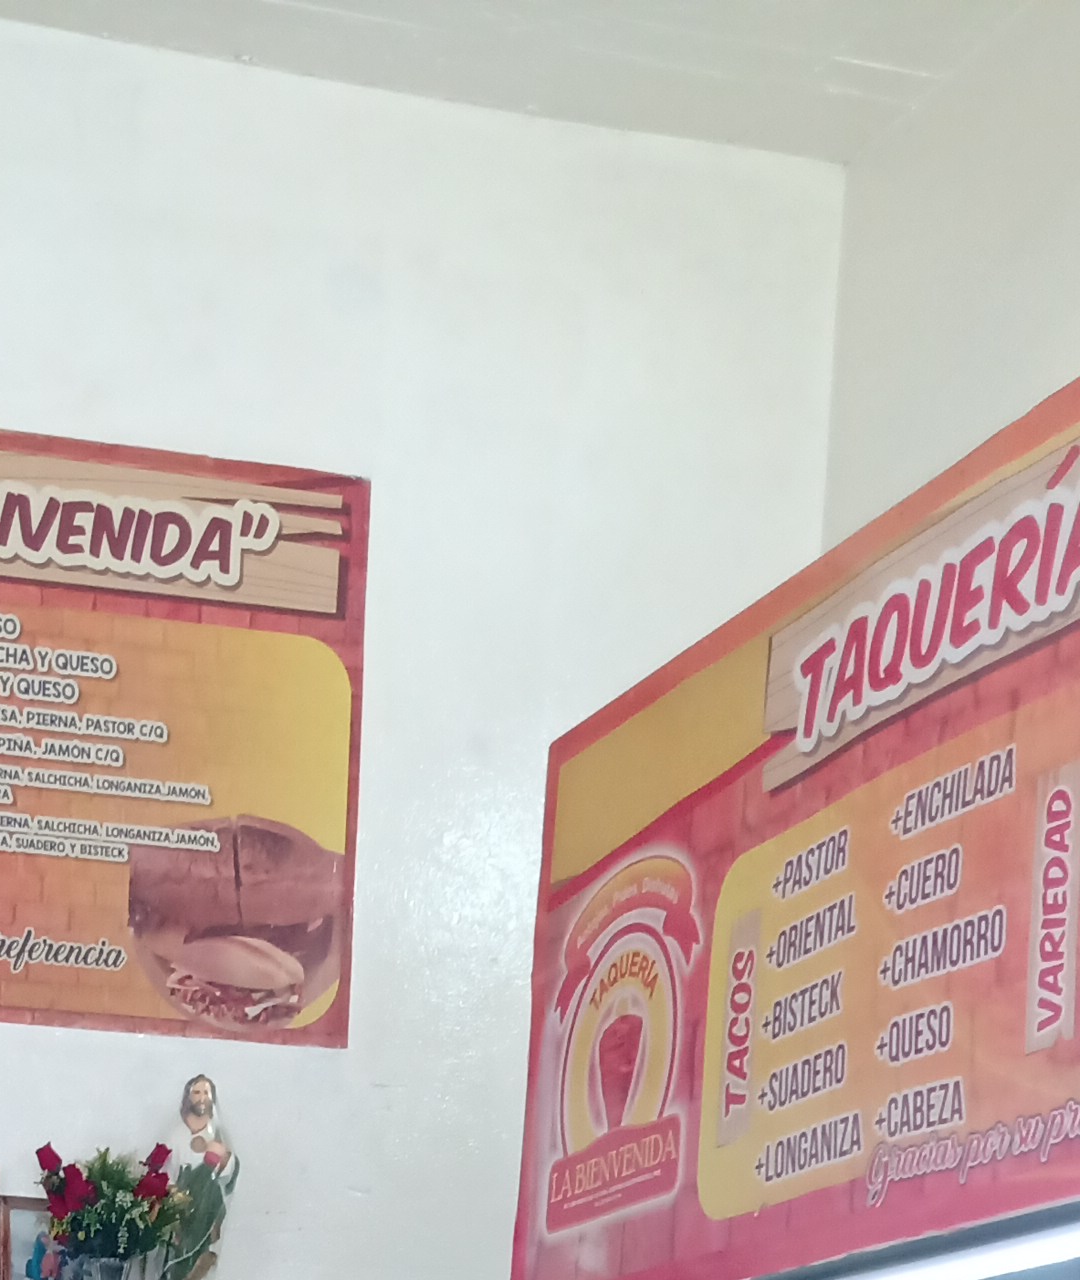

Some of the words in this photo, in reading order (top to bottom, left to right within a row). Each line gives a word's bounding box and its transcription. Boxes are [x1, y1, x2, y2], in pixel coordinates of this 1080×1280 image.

[38, 650, 49, 668] Y
[55, 653, 114, 675] QUESO
[17, 678, 76, 700] QUESO
[86, 718, 136, 736] PASTOR
[140, 724, 164, 739] C/Q
[42, 742, 92, 760] JAMÓN
[95, 748, 120, 763] C/Q
[16, 838, 66, 853] SUADERO
[70, 842, 77, 854] Y
[80, 844, 125, 859] BISTECK
[1037, 788, 1072, 1032] VARIEDAD
[725, 949, 756, 1118] TACOS
[550, 1169, 572, 1203] LA
[574, 1130, 677, 1194] BIENVENIDA
[866, 1134, 963, 1208] Gracias
[959, 1121, 1012, 1185] por
